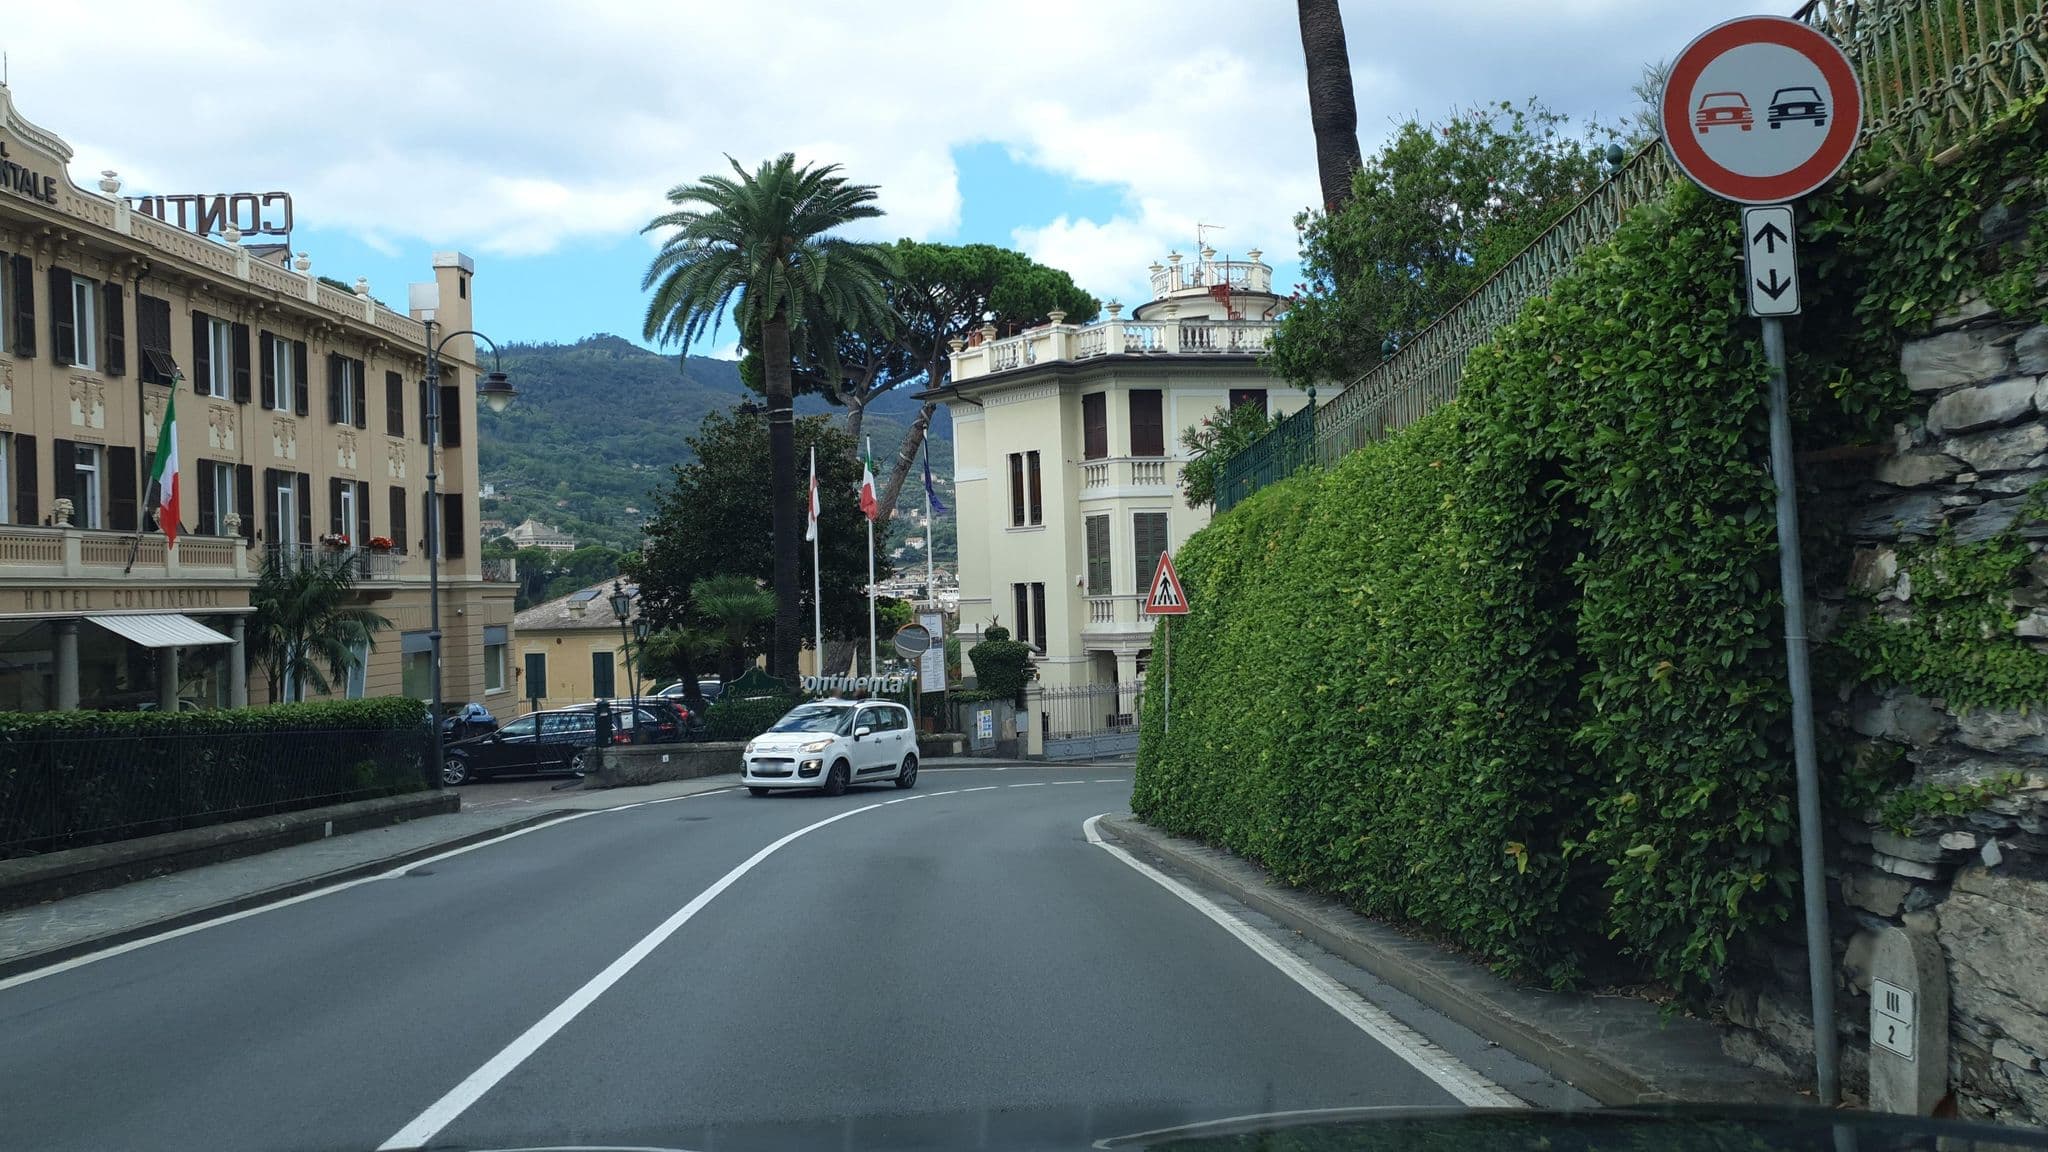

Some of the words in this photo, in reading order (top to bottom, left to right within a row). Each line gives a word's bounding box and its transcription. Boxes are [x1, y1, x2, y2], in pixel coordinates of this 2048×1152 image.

[24, 588, 92, 611] HOTEL
[113, 588, 220, 608] CONTINENTAL
[1888, 1025, 1895, 1045] 2
